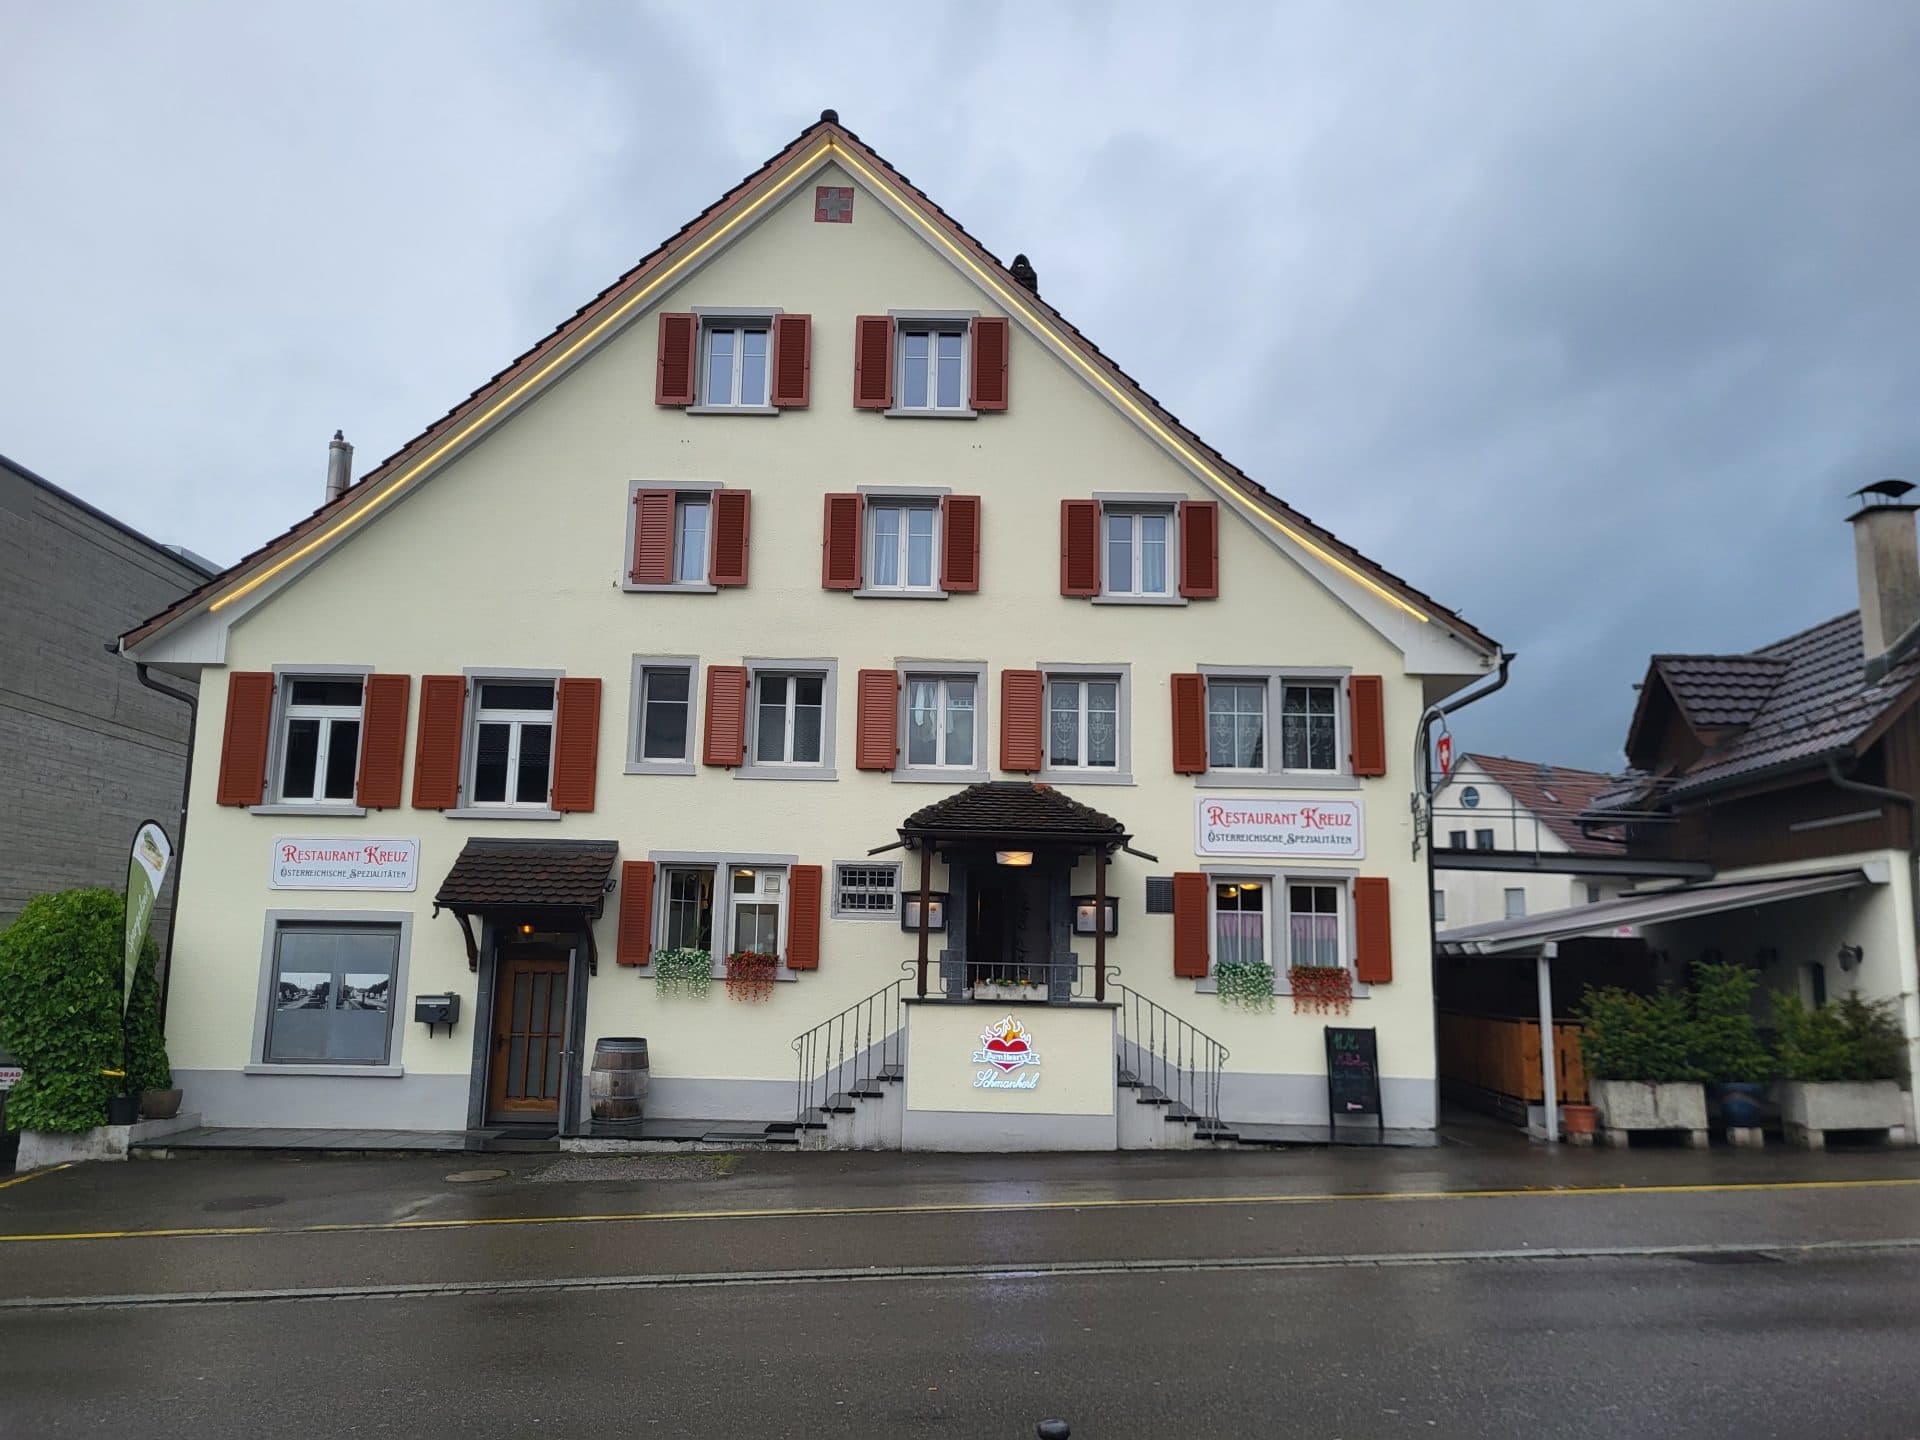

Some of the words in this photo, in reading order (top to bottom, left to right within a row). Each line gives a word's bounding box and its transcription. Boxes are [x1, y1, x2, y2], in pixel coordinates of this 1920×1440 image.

[1207, 806, 1297, 827] RESTAURANT
[1300, 807, 1352, 829] KREUZ
[1208, 830, 1284, 843] ÖSTERREICHISCHE
[1284, 832, 1352, 845] SPEZIALITÄTEN
[282, 845, 361, 864] RESTAURANT
[363, 846, 408, 865] KREUZ
[439, 1008, 448, 1021] 2
